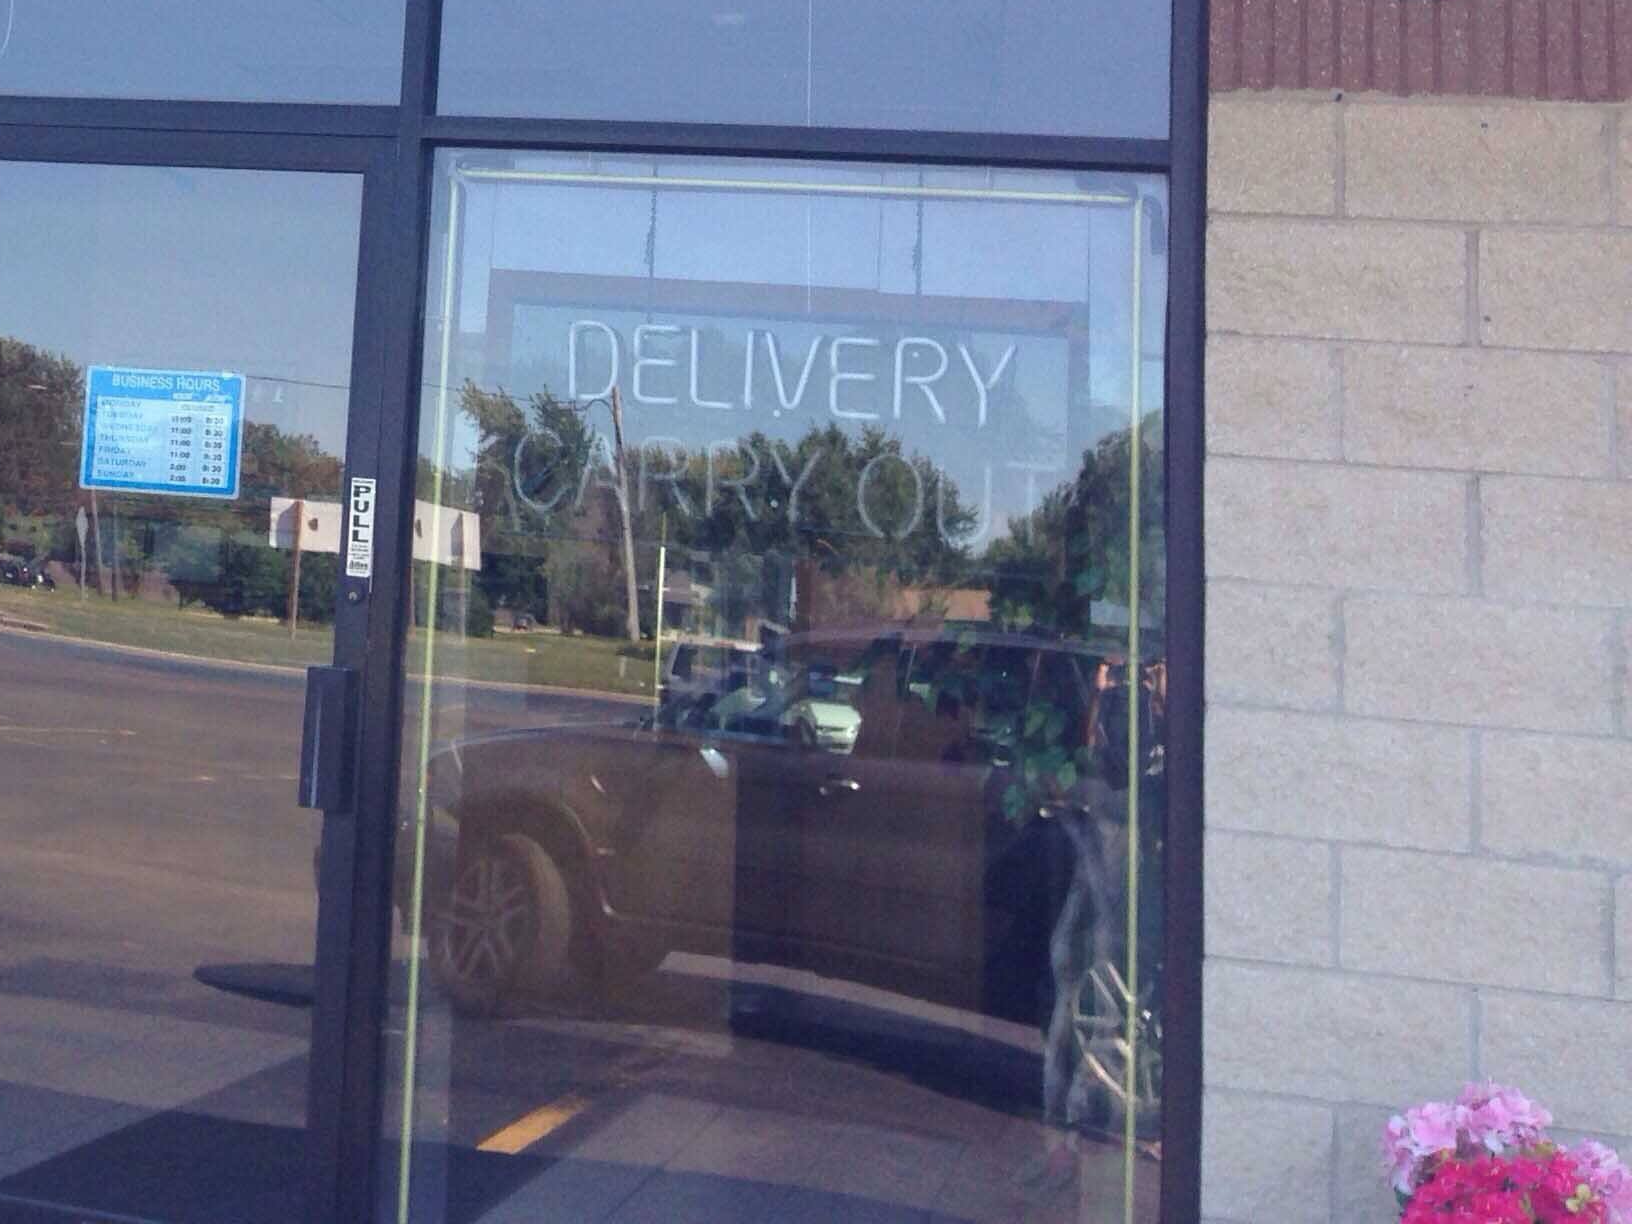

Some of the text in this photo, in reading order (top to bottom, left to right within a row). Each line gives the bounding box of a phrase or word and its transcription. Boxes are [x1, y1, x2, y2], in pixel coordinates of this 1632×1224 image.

[112, 374, 221, 392] BUSINESS HOURS
[569, 319, 1018, 426] DELIVERY
[352, 485, 372, 543] PULL
[514, 429, 1069, 547] CARRY OUT
